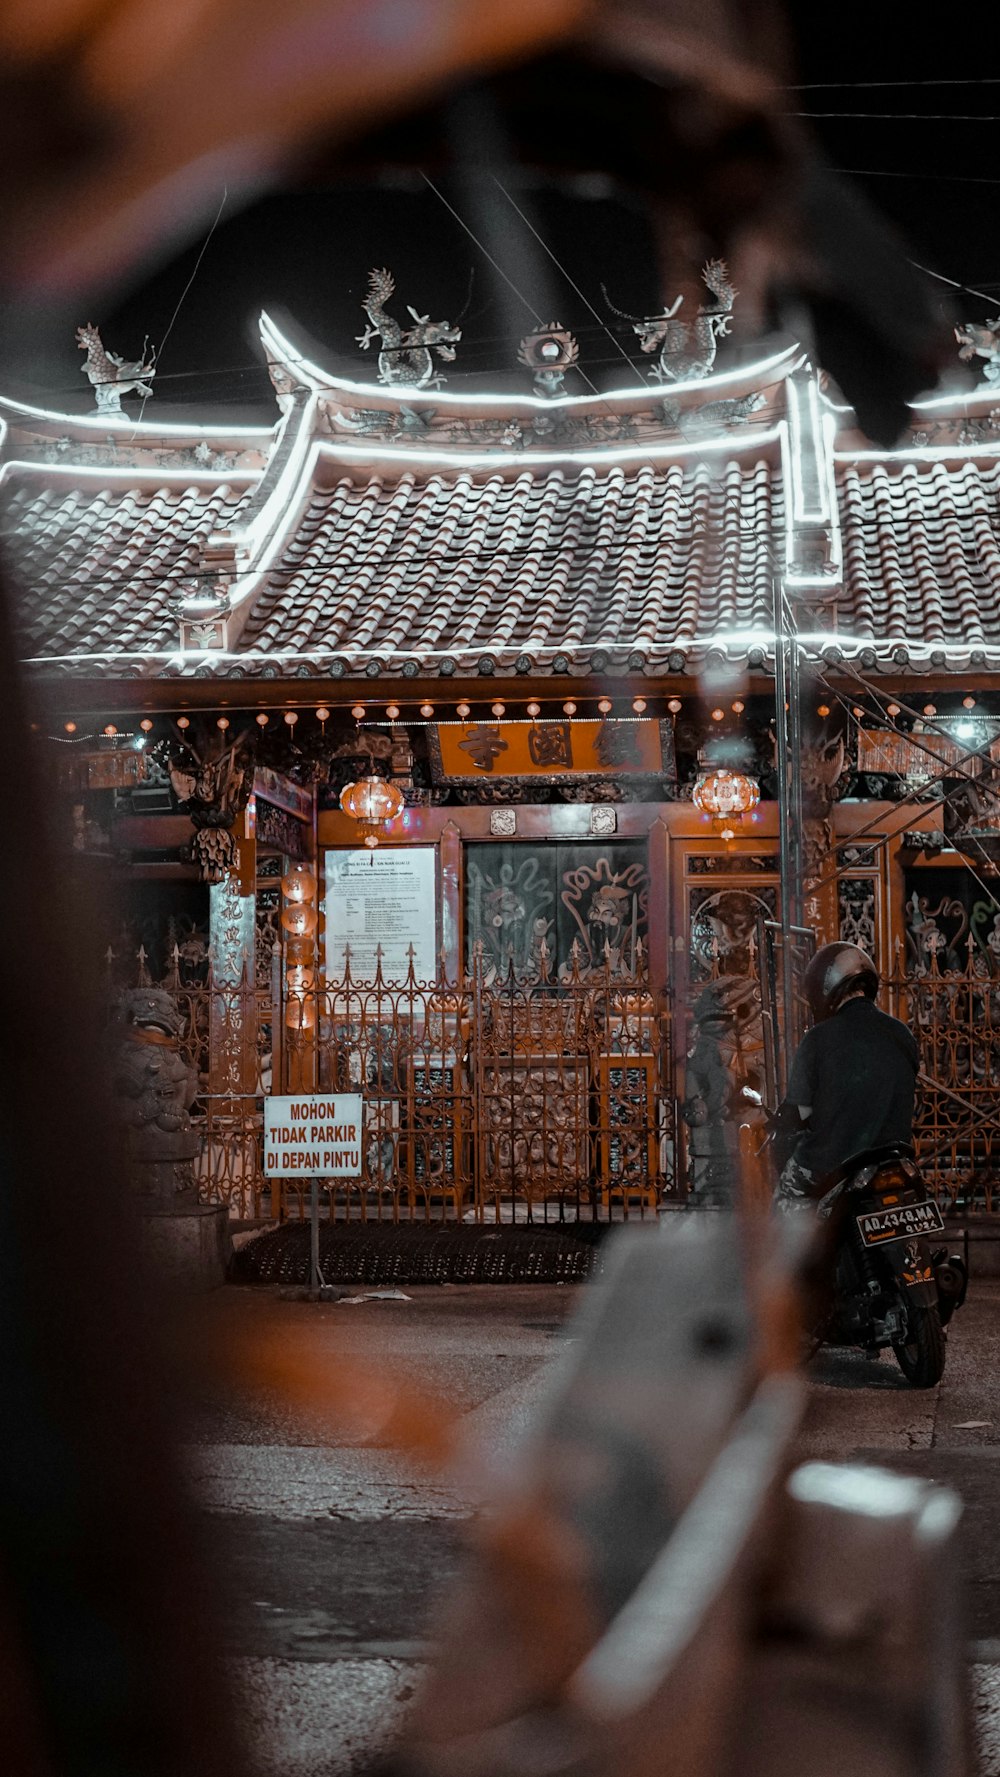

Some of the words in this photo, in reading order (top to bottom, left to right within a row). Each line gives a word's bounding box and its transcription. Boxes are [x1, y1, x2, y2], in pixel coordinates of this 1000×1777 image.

[290, 1102, 335, 1120] MOHON
[270, 1126, 307, 1143] TIDAK
[311, 1125, 356, 1142] PARKIR
[267, 1152, 278, 1169] DI
[282, 1152, 320, 1169] DEPAN
[323, 1151, 358, 1168] PINTU
